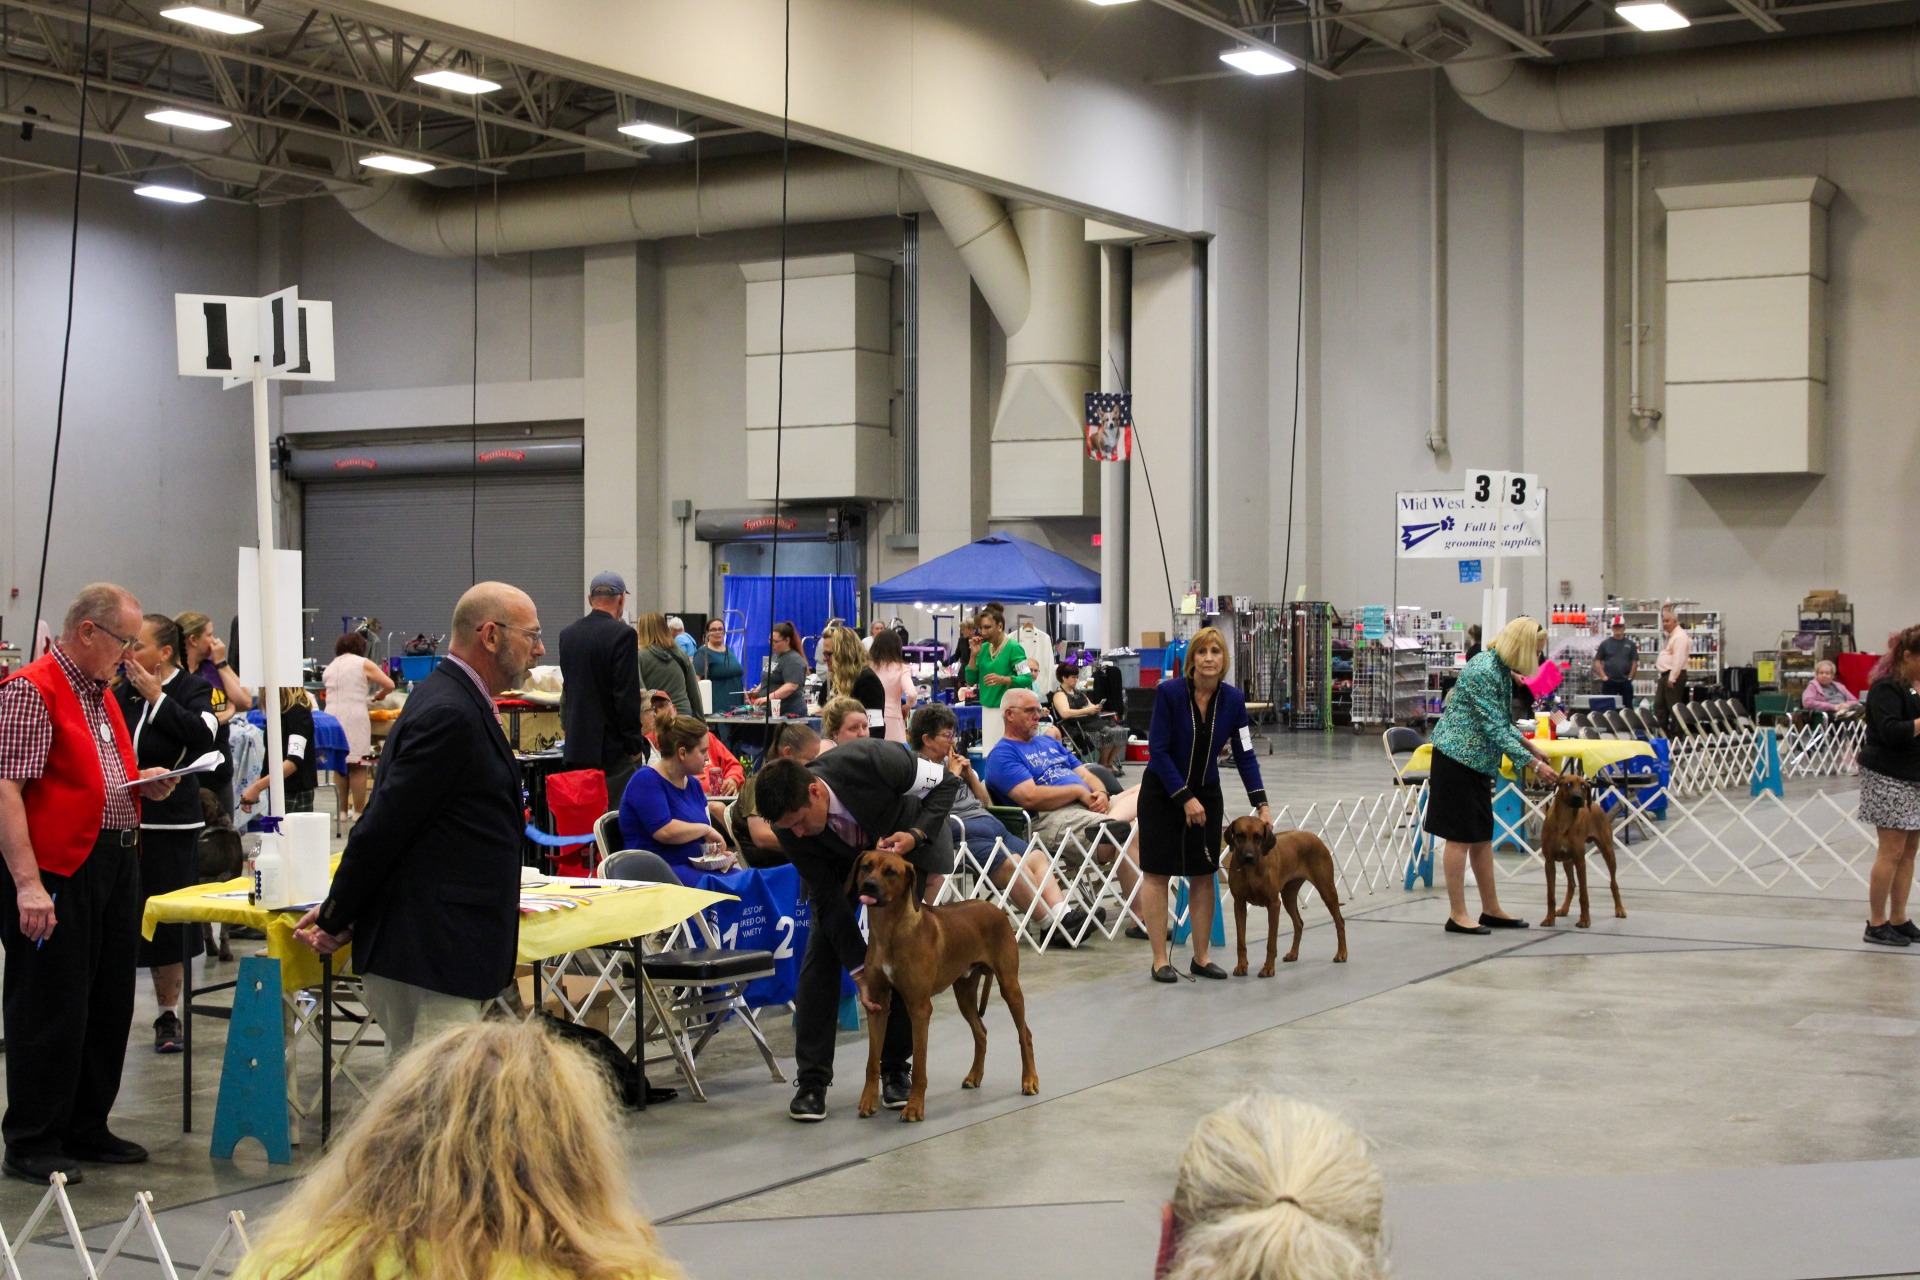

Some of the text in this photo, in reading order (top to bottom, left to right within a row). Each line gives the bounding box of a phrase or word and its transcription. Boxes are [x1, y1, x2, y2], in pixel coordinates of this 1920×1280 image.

[1475, 475, 1491, 502] 3
[1510, 478, 1527, 505] 3
[1400, 497, 1427, 511] Mid
[1432, 497, 1465, 510] West
[1464, 521, 1526, 533] Full lie of
[1444, 538, 1496, 549] grooming
[753, 905, 763, 914] OF
[795, 909, 806, 917] OF
[755, 916, 767, 925] OR
[858, 904, 870, 946] 4
[722, 922, 739, 951] 1
[773, 915, 794, 960] 2
